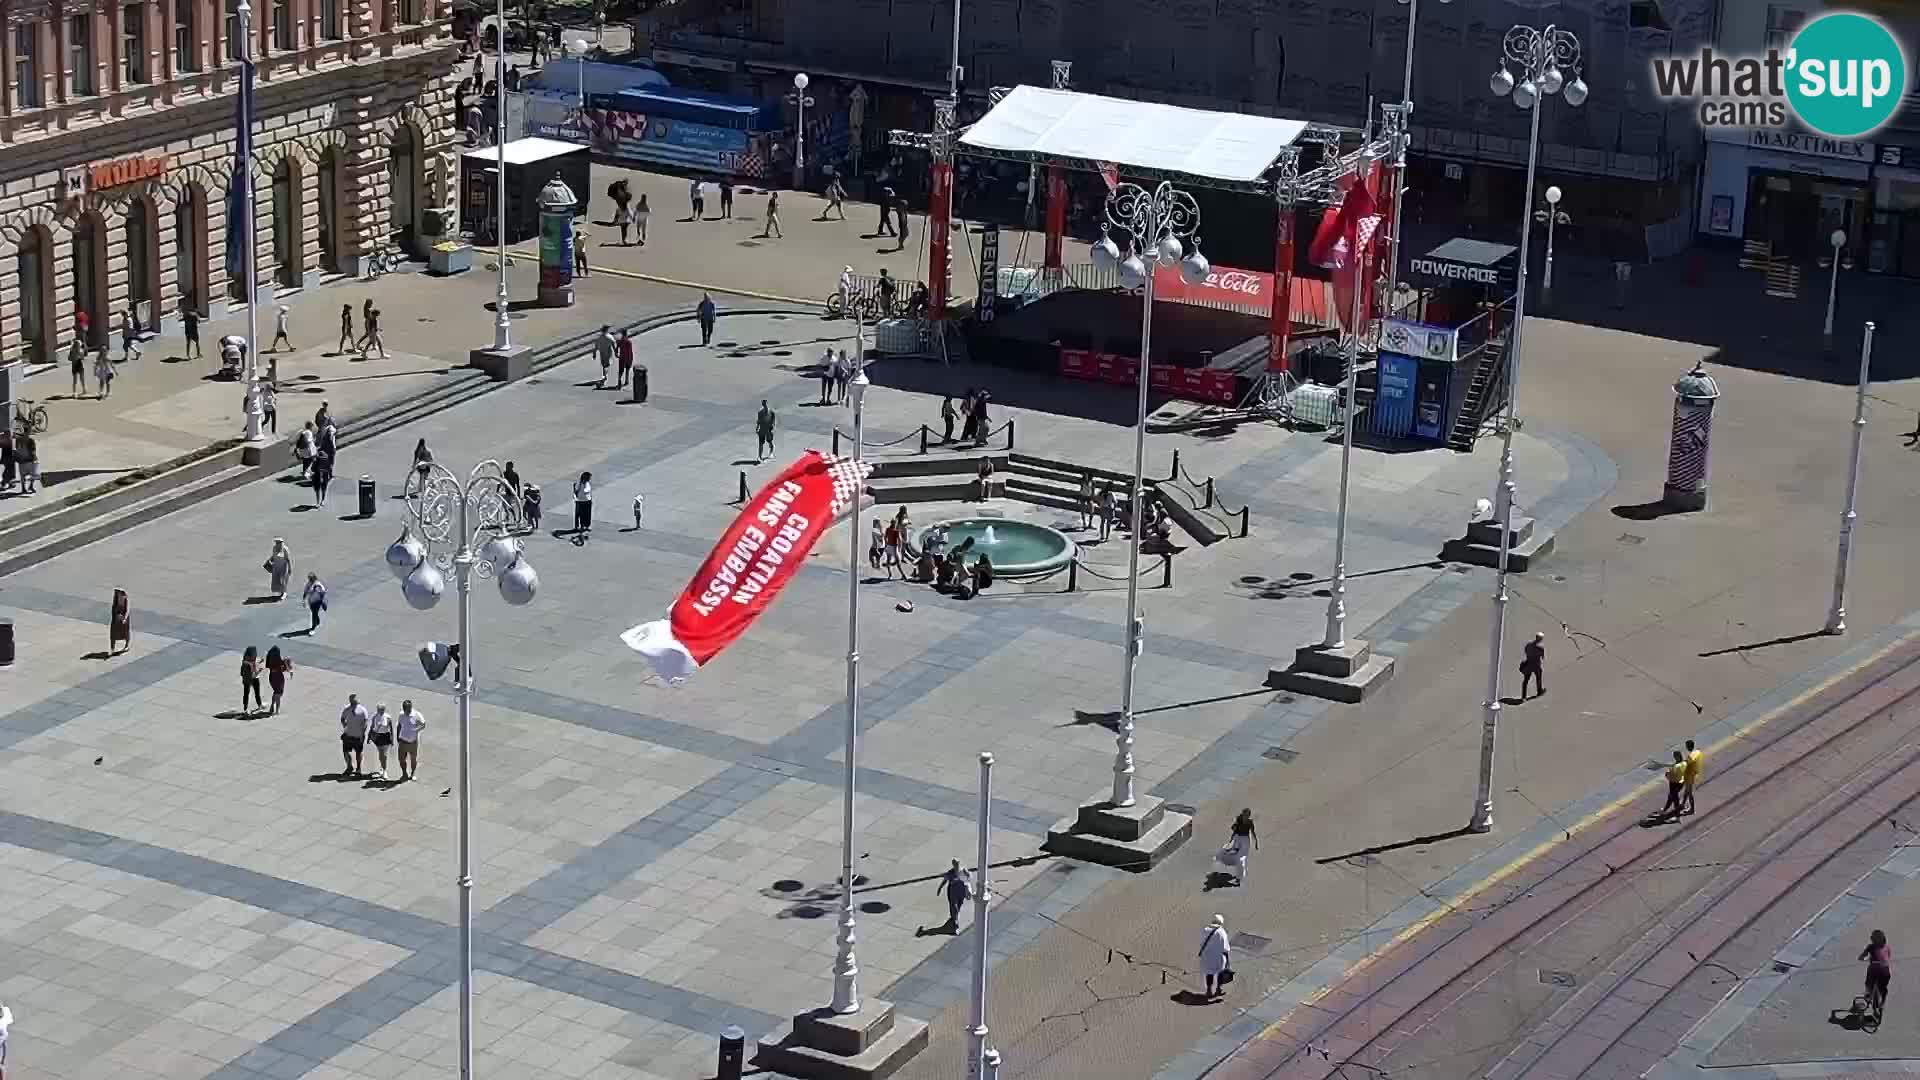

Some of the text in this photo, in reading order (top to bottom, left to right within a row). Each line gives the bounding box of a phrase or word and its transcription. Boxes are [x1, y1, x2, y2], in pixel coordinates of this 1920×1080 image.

[1753, 130, 1865, 157] MARTIMEX
[1411, 259, 1499, 284] POWERADE
[692, 480, 803, 617] FANS EMBASSY
[731, 513, 809, 605] CROATIAN
